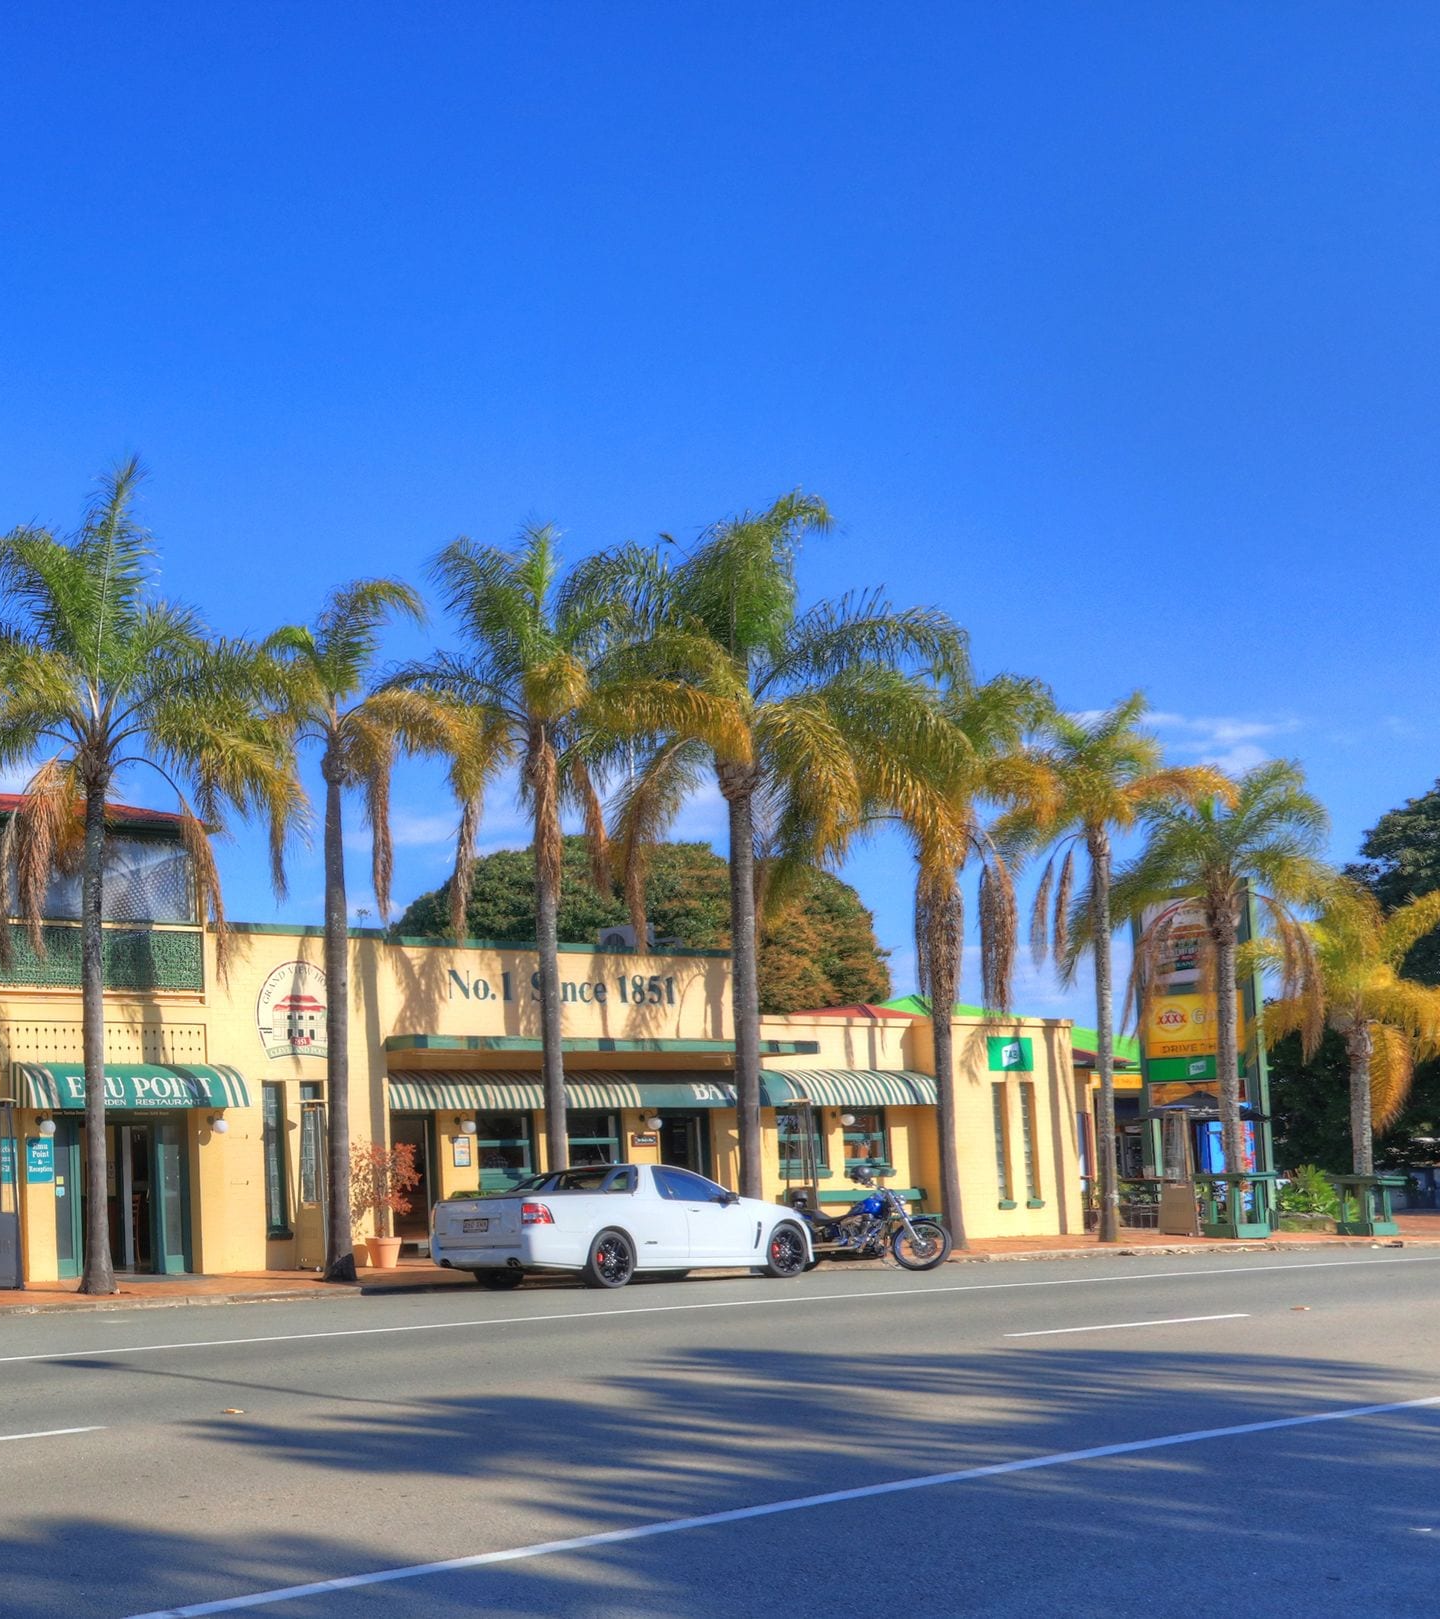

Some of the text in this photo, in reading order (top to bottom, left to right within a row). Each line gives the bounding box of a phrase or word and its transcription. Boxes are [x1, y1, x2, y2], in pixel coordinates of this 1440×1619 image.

[530, 971, 607, 1003] Snce
[617, 974, 675, 1005] 1851
[1162, 1043, 1199, 1054] DRIVE
[65, 1076, 213, 1099] EU POINT
[81, 1098, 201, 1107] RDEN RESTAURANT
[32, 1150, 49, 1158] Point
[28, 1165, 53, 1173] Reception
